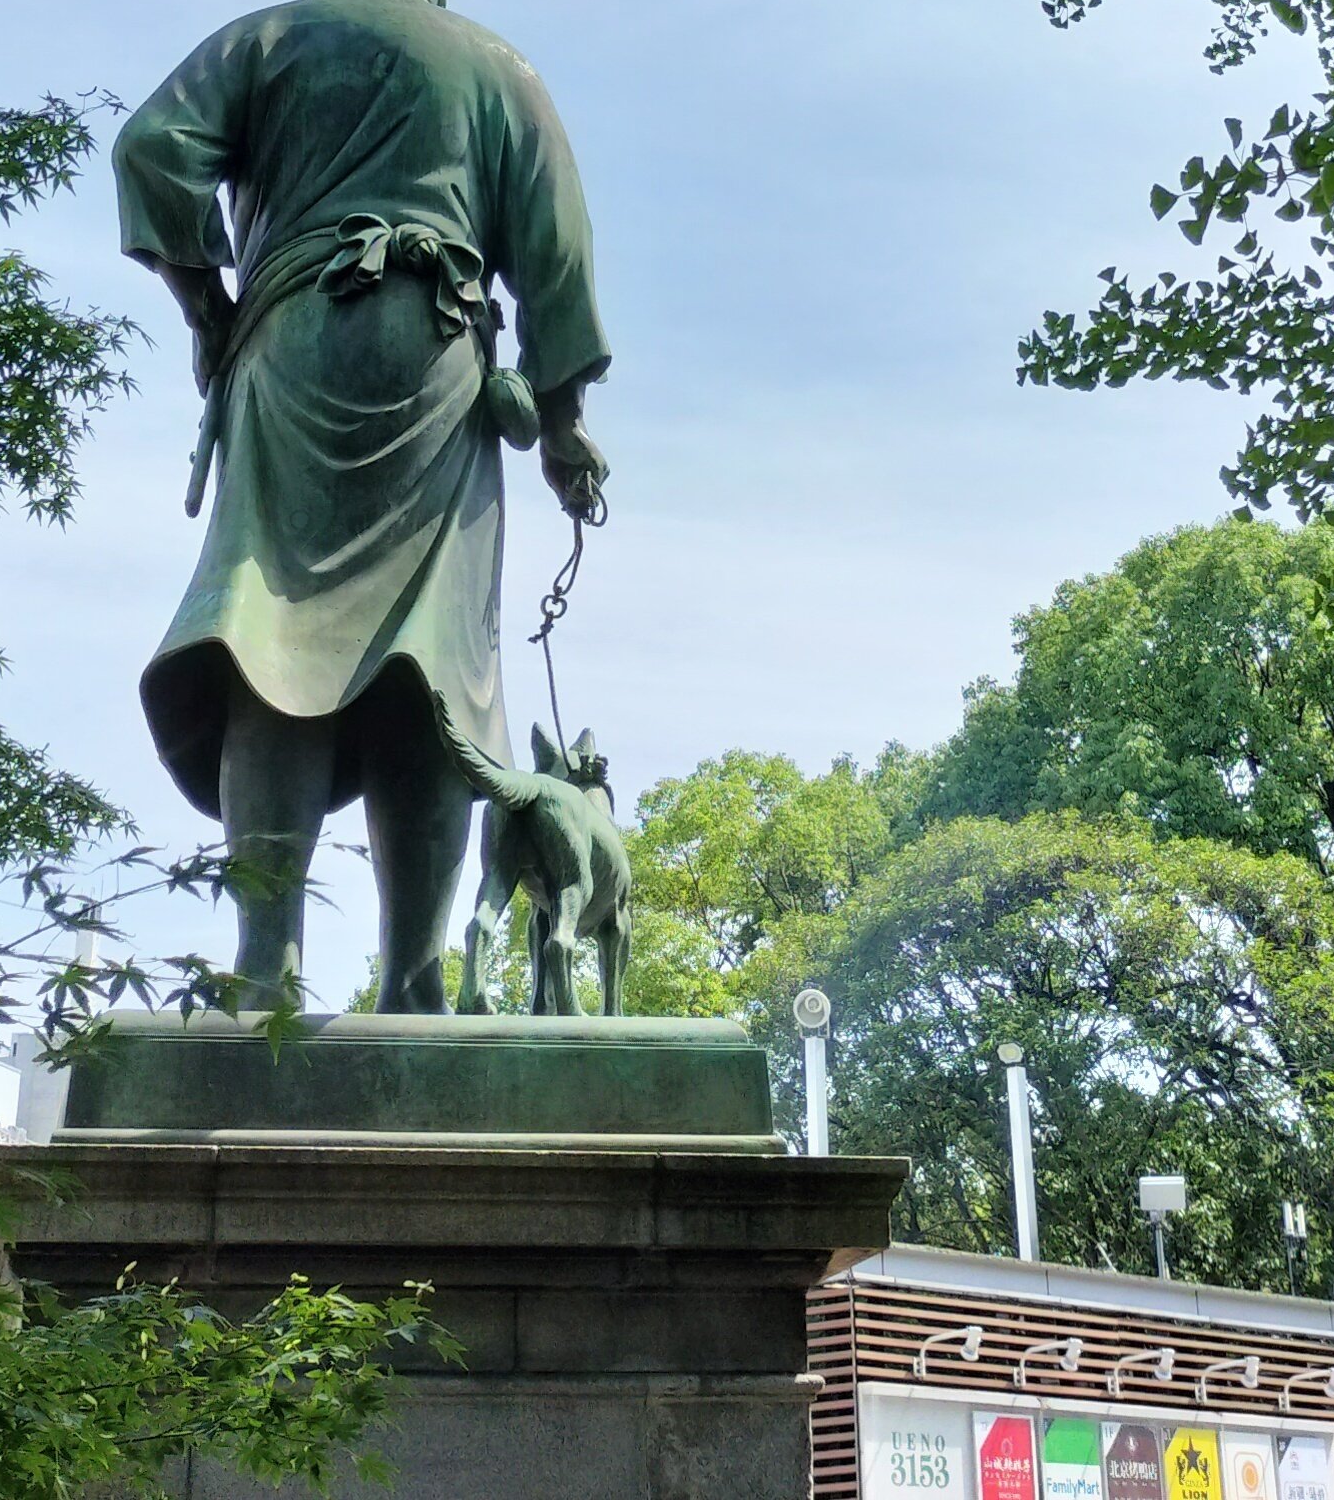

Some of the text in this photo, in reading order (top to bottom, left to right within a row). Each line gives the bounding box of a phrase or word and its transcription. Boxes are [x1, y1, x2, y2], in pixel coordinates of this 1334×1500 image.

[891, 1432, 946, 1452] UENO
[891, 1452, 950, 1489] 3153
[1046, 1477, 1100, 1498] FamilyMart
[1182, 1489, 1208, 1500] LION
